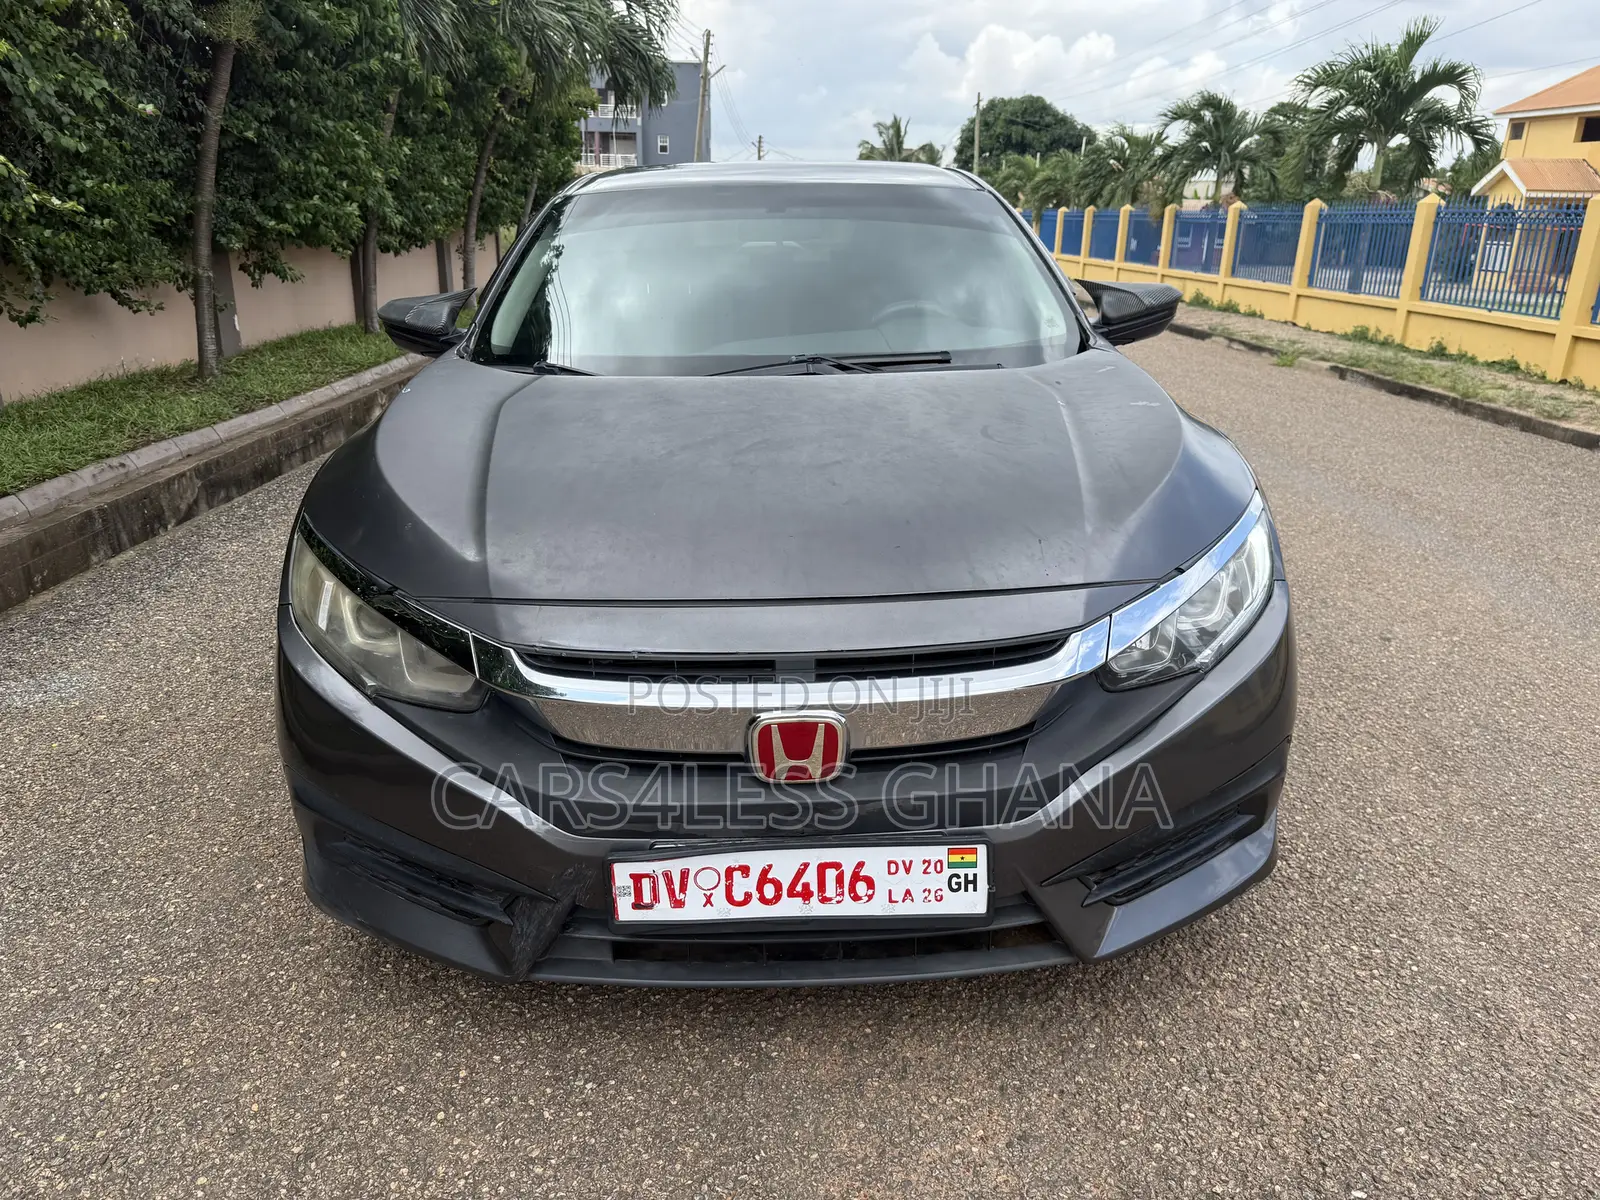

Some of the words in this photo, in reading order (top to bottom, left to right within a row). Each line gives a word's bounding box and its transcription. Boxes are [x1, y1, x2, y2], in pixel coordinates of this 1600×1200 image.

[887, 859, 913, 876] DV
[922, 858, 944, 875] 20
[629, 868, 690, 910] DV
[724, 861, 876, 907] C6406
[947, 873, 977, 893] GH
[888, 888, 914, 904] LA
